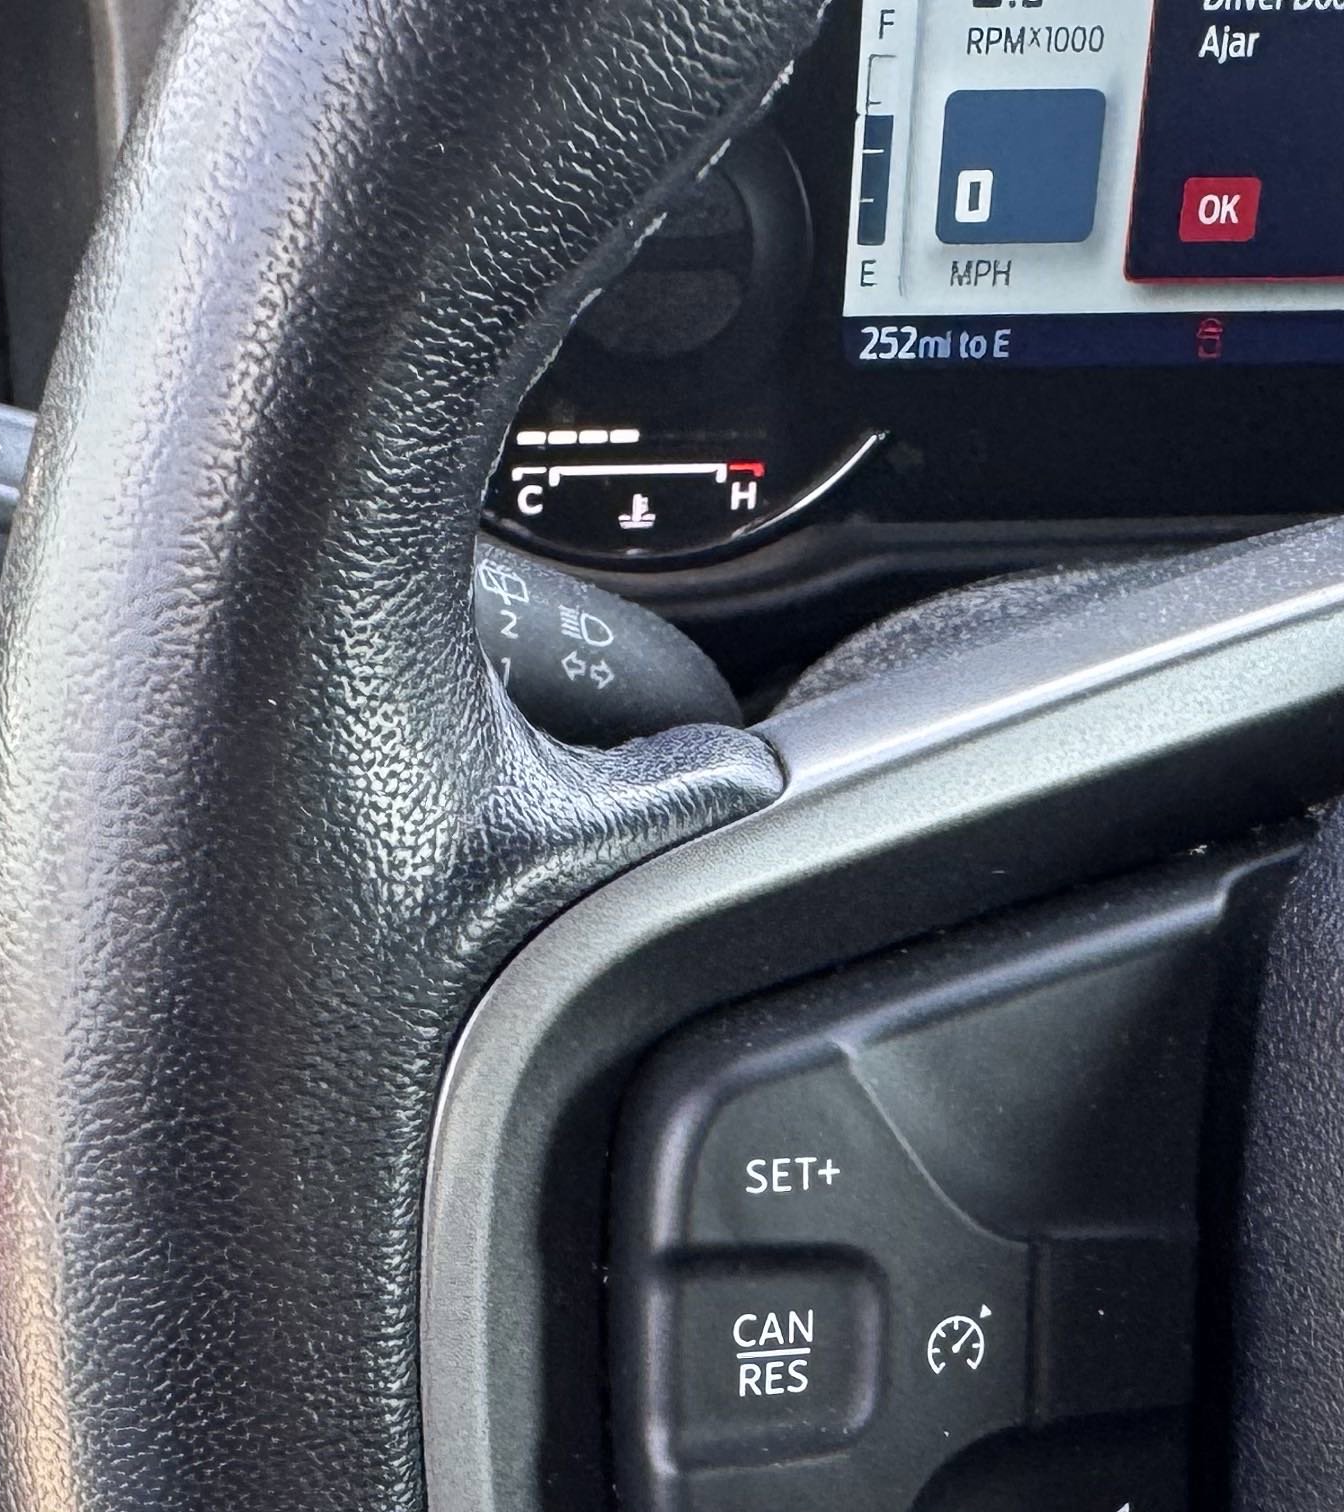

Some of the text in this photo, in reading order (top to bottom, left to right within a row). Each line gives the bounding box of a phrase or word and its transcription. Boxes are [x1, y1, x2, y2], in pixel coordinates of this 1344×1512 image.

[879, 10, 895, 39] F
[1198, 25, 1260, 64] Ajar
[956, 169, 993, 222] 0
[1198, 194, 1241, 225] OK
[860, 259, 876, 287] E
[950, 260, 1012, 287] MPH
[959, 331, 987, 360] to
[994, 329, 1012, 358] E
[517, 486, 543, 514] C
[730, 481, 757, 510] H
[499, 610, 519, 640] 2
[745, 1157, 841, 1194] SET+
[732, 1309, 814, 1348] CAN
[738, 1360, 809, 1397] RES
